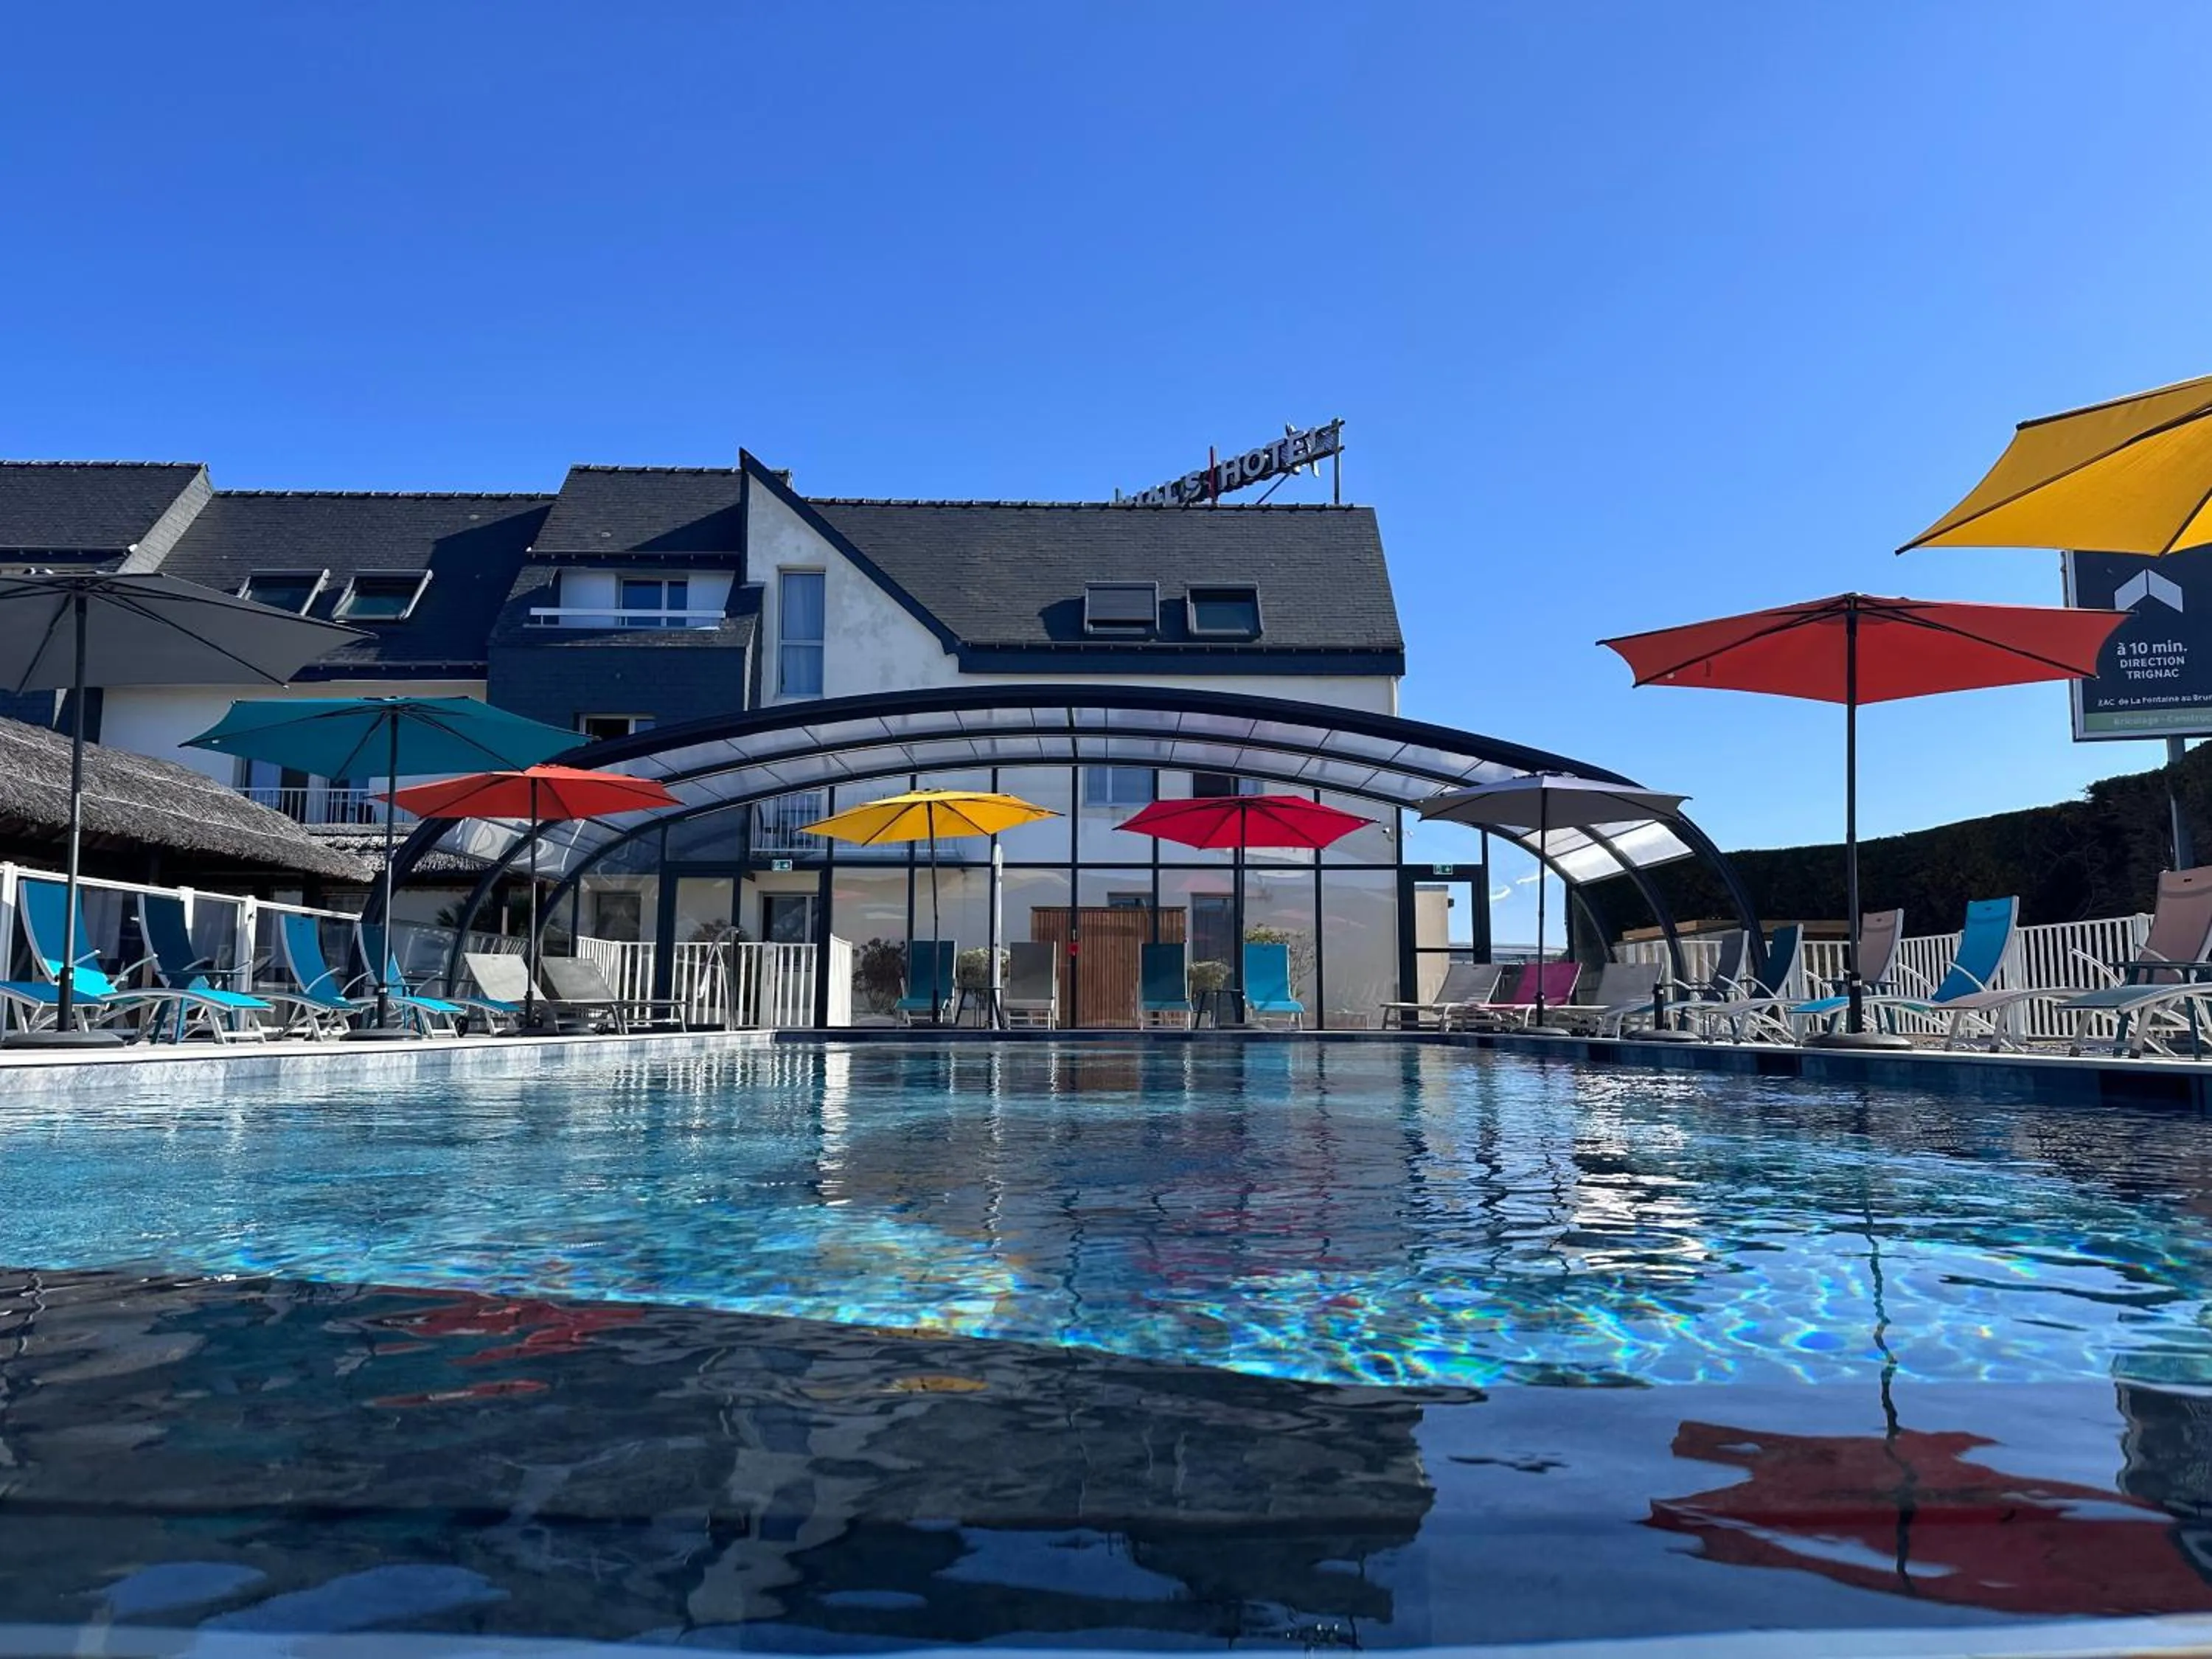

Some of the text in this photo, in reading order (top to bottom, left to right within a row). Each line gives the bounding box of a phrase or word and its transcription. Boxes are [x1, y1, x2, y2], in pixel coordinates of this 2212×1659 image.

[2117, 639, 2188, 655] à 10 min.
[2120, 655, 2185, 669] DIRECTION
[2126, 668, 2180, 679] TRIGNAC
[2098, 698, 2115, 706] ZAC
[2142, 695, 2180, 704] Fontaine
